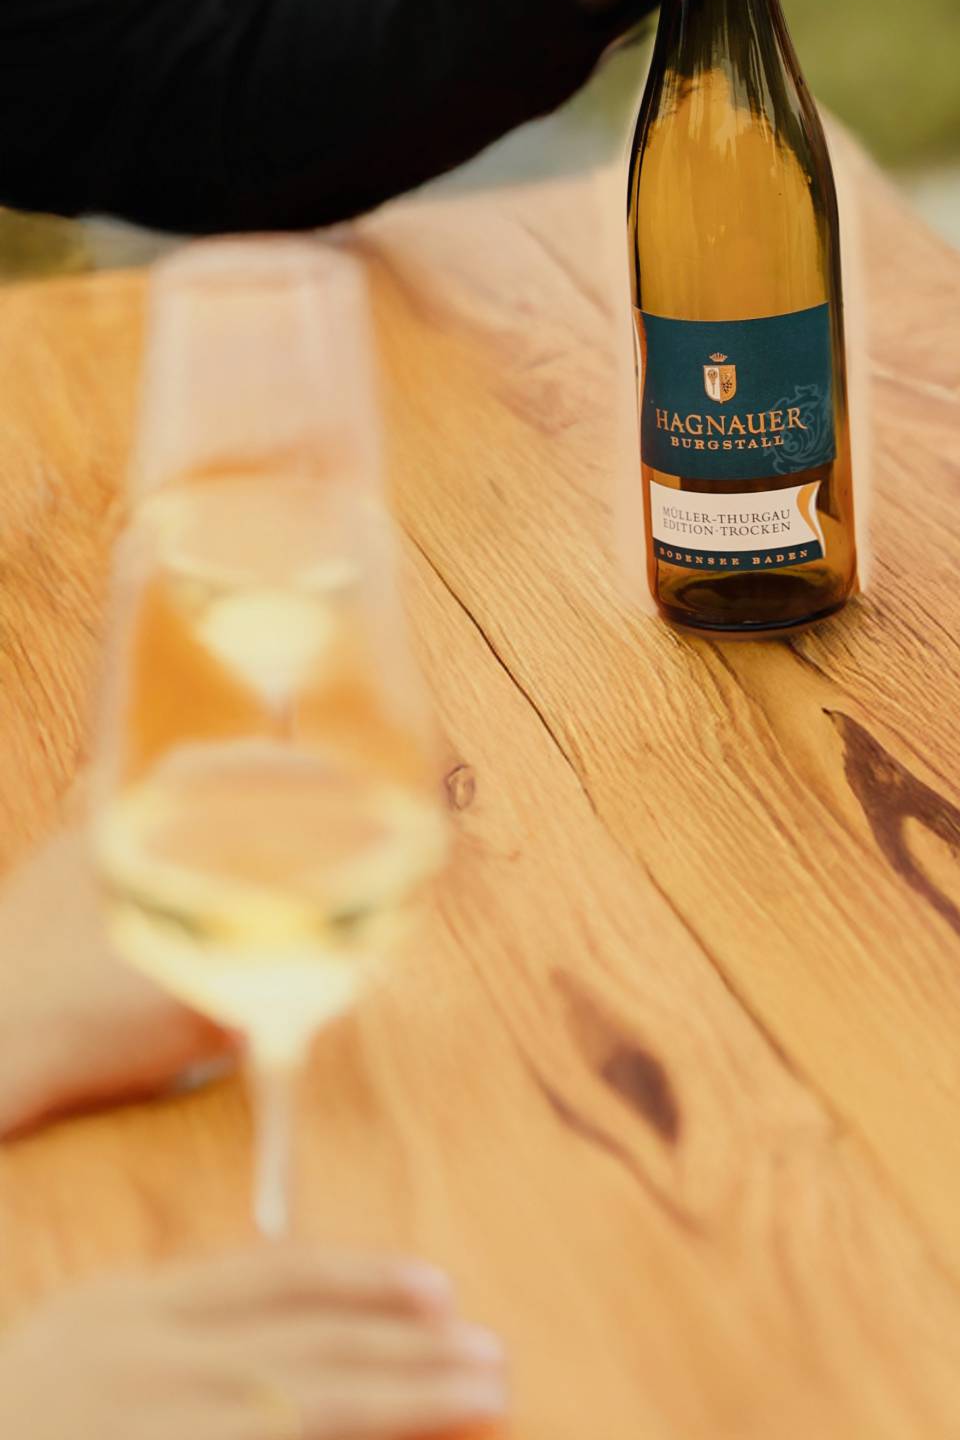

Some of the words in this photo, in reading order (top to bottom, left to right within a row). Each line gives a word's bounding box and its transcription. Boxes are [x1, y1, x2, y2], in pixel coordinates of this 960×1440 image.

[655, 407, 808, 435] HAGNAUER
[670, 435, 785, 450] BURGSTALL
[659, 546, 740, 566] BODENSEE
[752, 549, 808, 565] BADEN
